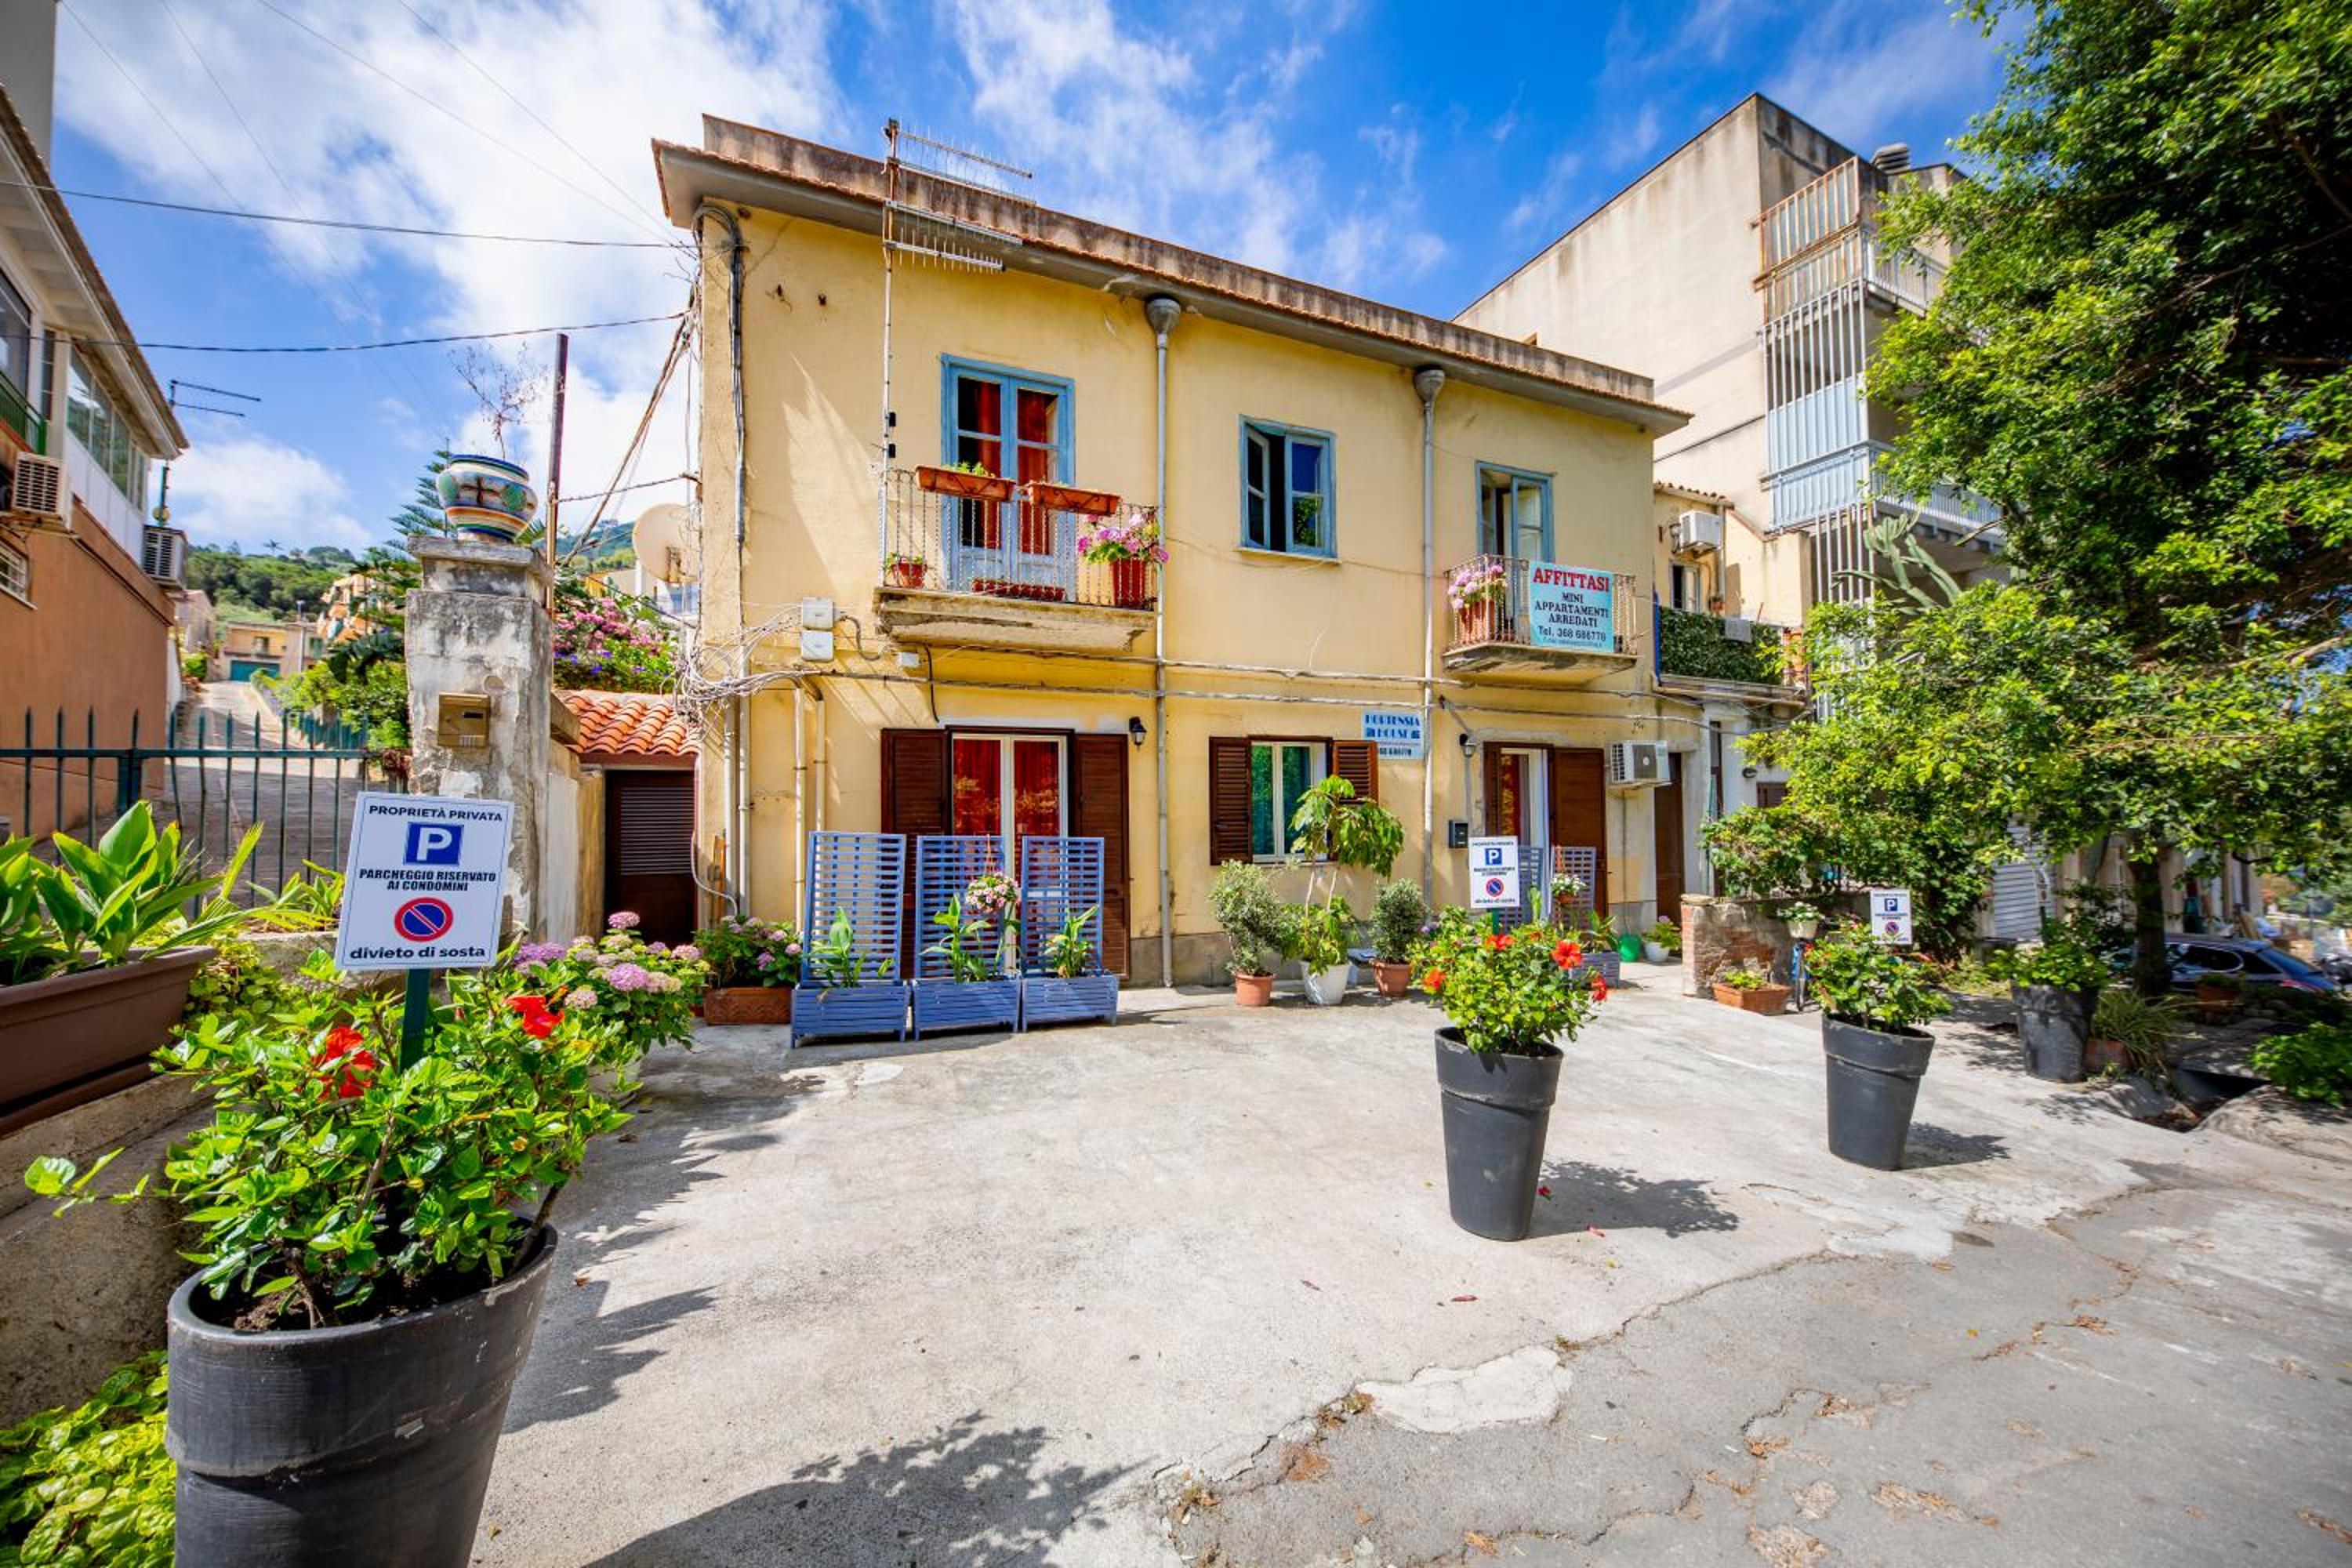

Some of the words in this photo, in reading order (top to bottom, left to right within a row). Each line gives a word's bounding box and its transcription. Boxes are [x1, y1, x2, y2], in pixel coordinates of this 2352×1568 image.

[1534, 567, 1610, 592] AFFITTASI
[1562, 592, 1584, 603] MINI
[1534, 601, 1609, 619] APPARTAMENTI
[1548, 613, 1598, 628] ARREDATI
[1537, 626, 1554, 637] Tel.
[1557, 628, 1573, 639] 368
[369, 805, 446, 818] PROPRIETÀ
[449, 810, 503, 822] PRIVATA
[416, 827, 452, 861] P
[1489, 850, 1499, 865] P
[359, 869, 434, 880] PARCHEGGIO
[437, 870, 496, 882] RISERVATO
[387, 880, 400, 890] AI
[402, 881, 468, 891] CONDOMINI
[1887, 899, 1895, 911] P
[350, 946, 414, 959] divieto
[419, 946, 435, 957] di
[440, 946, 485, 957] sosta
